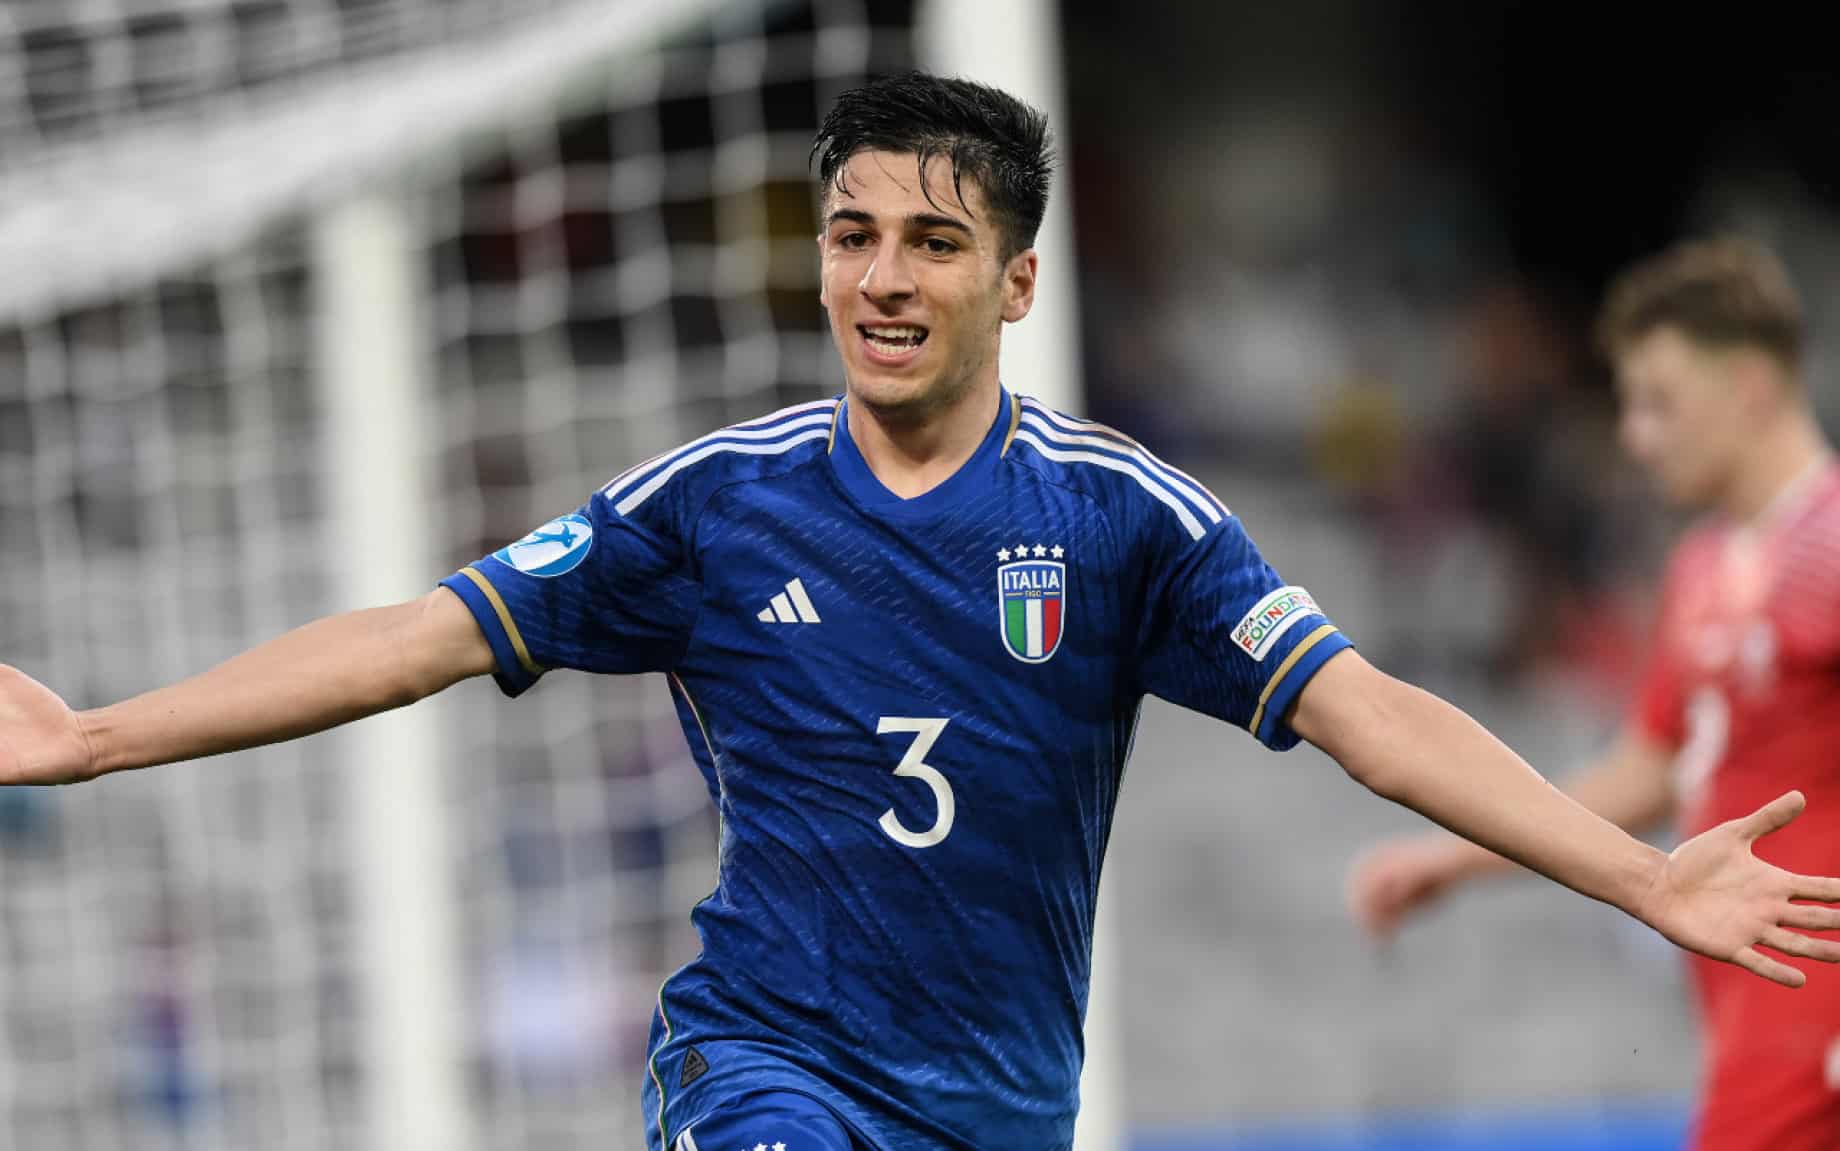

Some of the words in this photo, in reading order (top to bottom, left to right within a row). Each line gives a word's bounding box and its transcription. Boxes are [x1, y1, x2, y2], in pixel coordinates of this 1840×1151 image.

[1004, 570, 1060, 590] ITALIA
[1235, 616, 1256, 641] UEFA
[876, 716, 955, 849] 3
